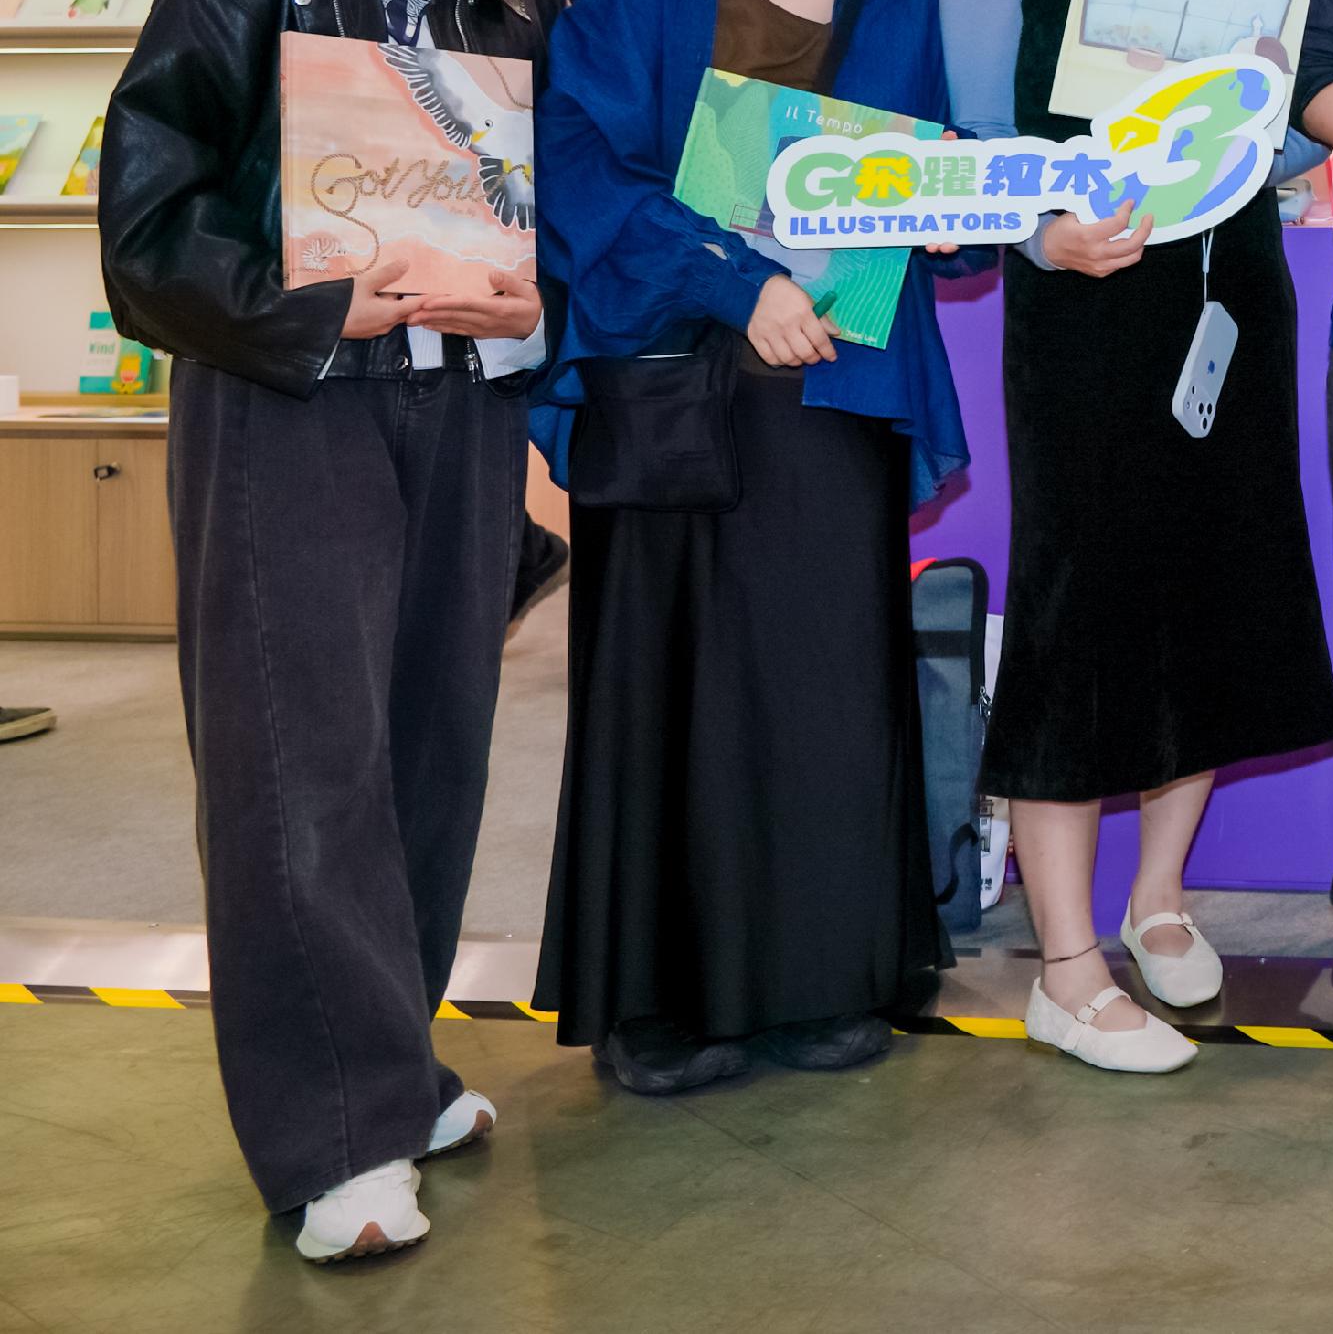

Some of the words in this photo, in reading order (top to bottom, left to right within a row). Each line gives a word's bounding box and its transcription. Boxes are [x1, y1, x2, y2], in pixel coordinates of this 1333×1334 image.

[807, 109, 863, 134] Tempo
[311, 153, 400, 217] Got
[400, 157, 485, 208] You
[790, 212, 1022, 236] ILLUSTRATORS
